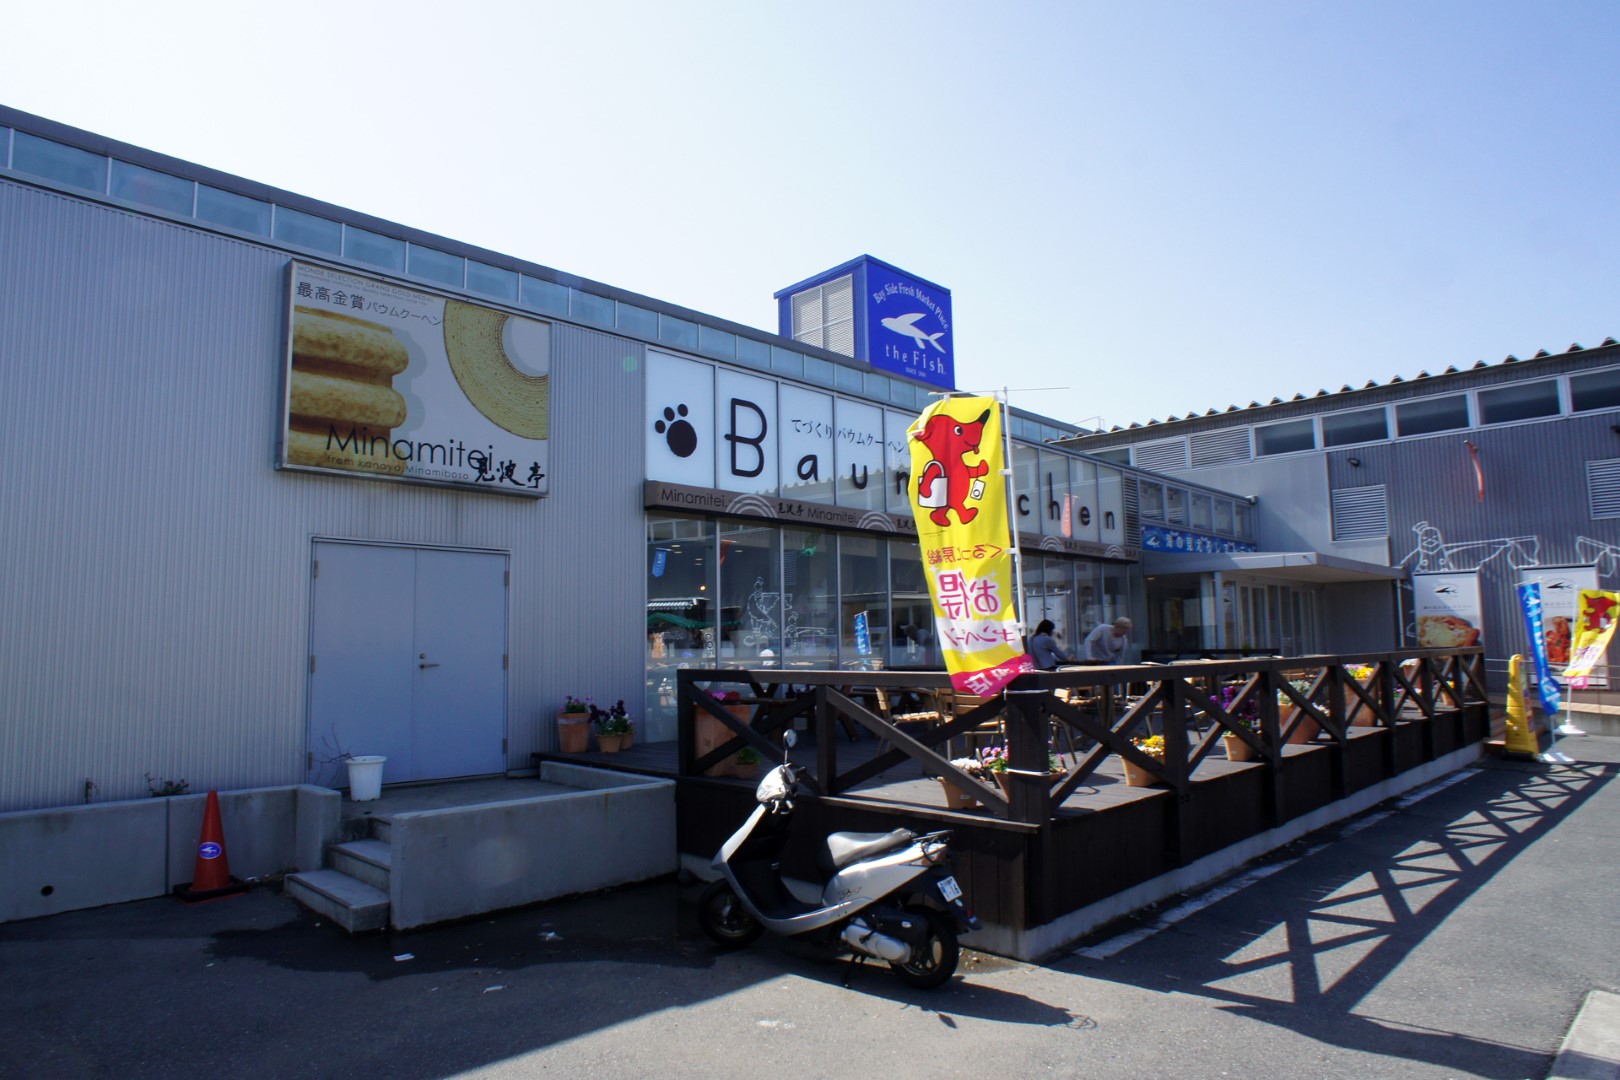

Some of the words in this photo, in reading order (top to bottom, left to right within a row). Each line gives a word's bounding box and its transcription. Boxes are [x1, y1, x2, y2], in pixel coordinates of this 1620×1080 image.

[873, 290, 887, 304] Bay
[884, 283, 899, 296] Side
[898, 282, 915, 297] Fresh
[915, 287, 935, 312] Market
[885, 343, 908, 363] the
[913, 350, 945, 375] Fish
[326, 425, 494, 472] Minamitei
[327, 454, 354, 466] from
